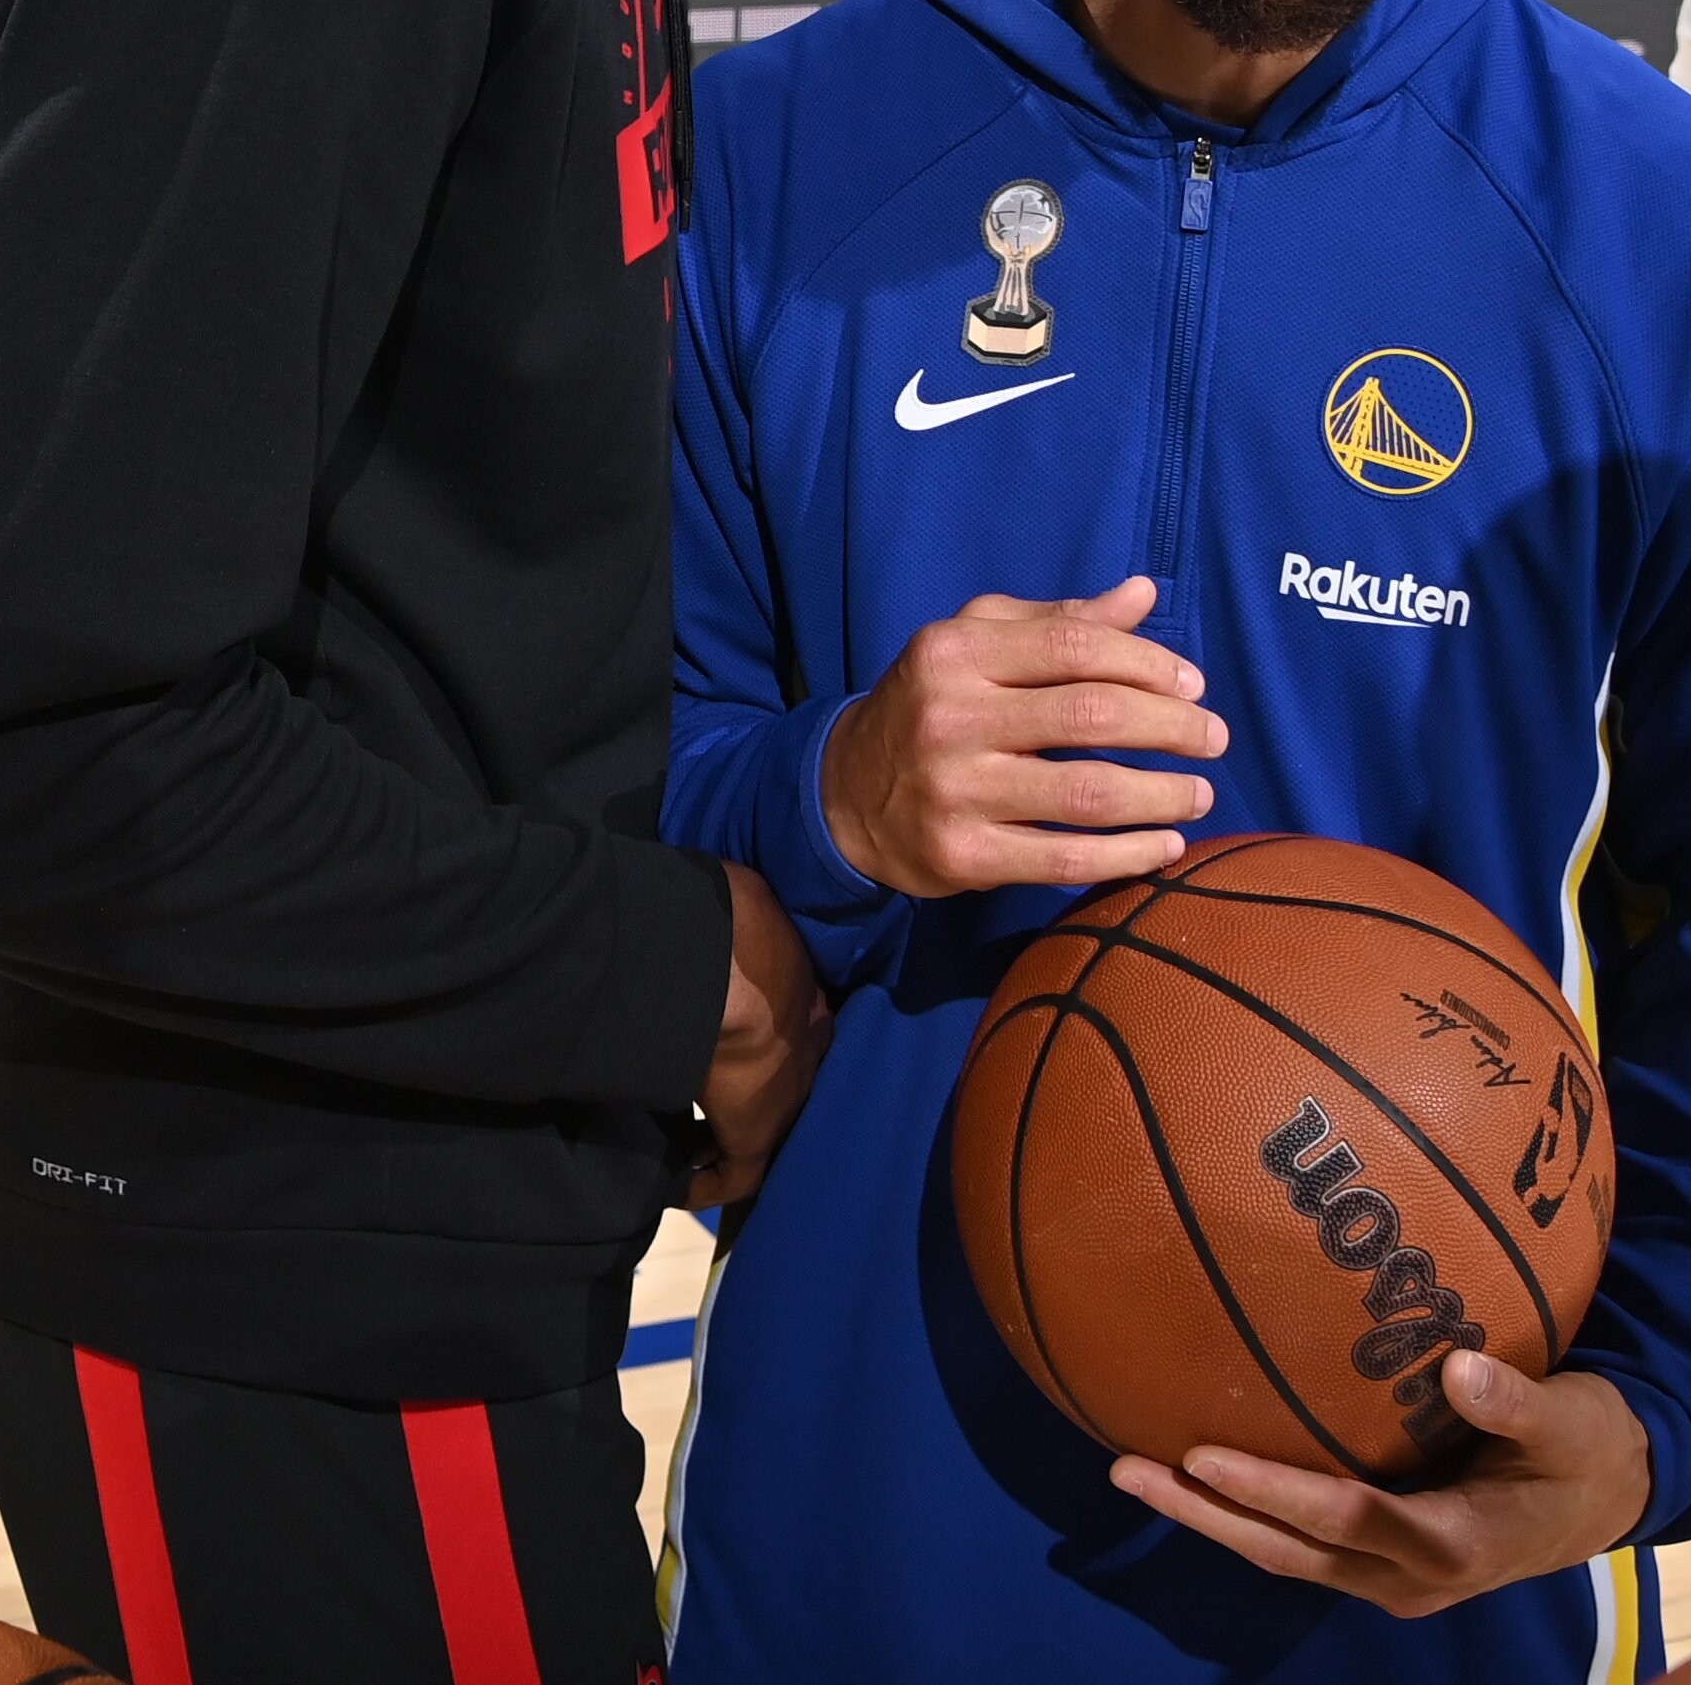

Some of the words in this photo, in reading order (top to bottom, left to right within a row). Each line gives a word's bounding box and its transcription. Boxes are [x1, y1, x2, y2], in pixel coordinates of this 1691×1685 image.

[1279, 552, 1469, 627] Rakuten
[32, 1157, 128, 1195] DRI-FIT
[1259, 1095, 1488, 1450] ilson
